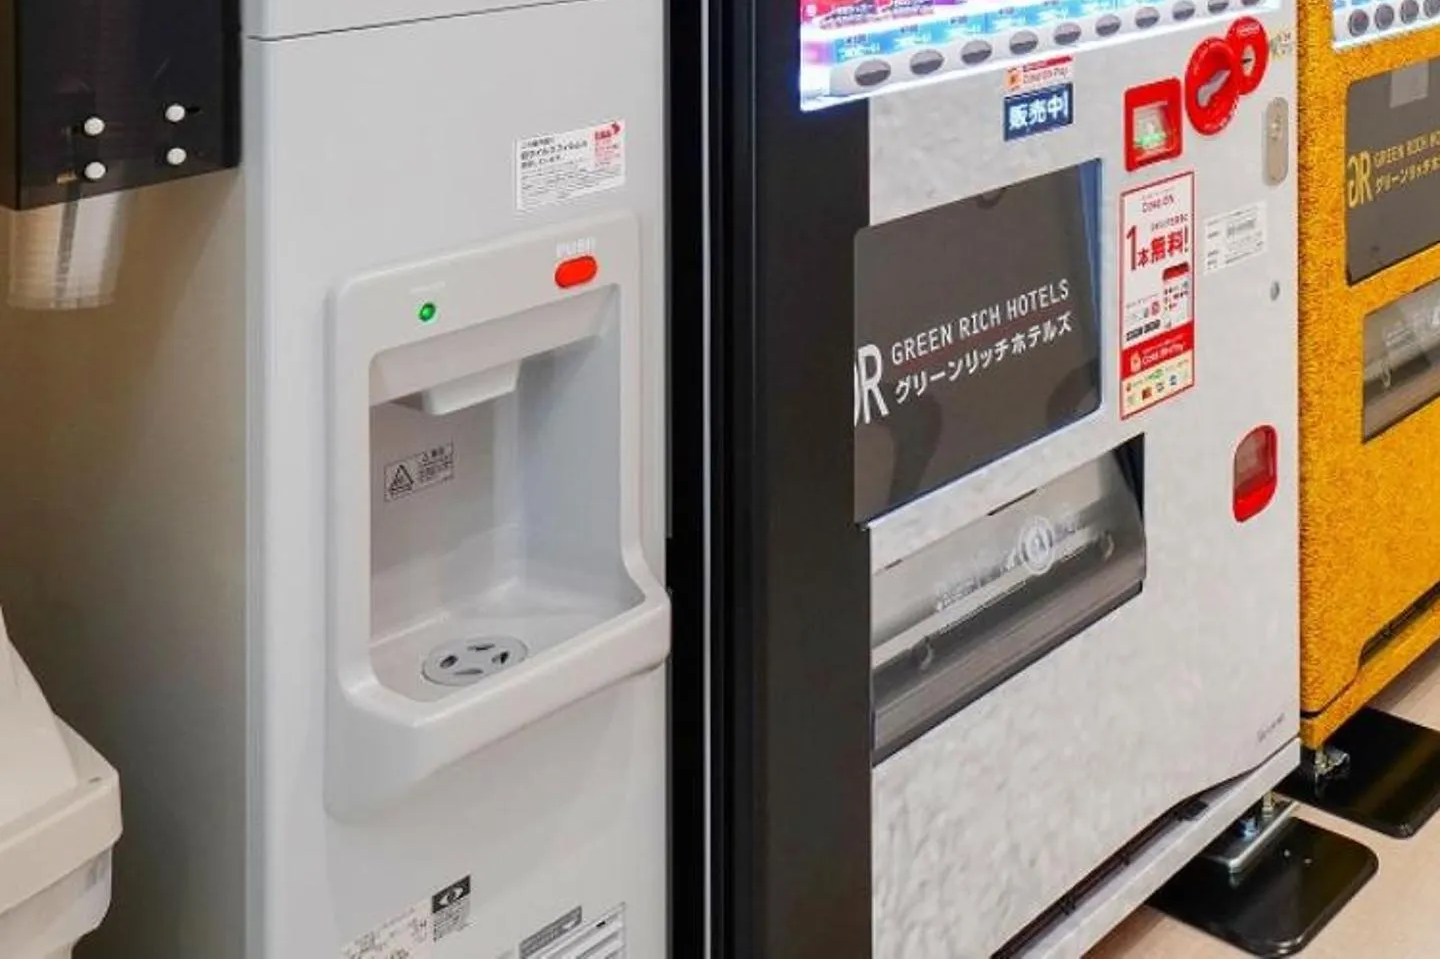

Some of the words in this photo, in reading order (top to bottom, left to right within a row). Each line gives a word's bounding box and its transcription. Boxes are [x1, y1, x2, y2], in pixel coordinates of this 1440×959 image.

[891, 322, 953, 366] GREEN
[958, 304, 1002, 339] RICH
[1006, 278, 1071, 321] HOTELS
[895, 310, 1074, 404] グリーンリッチホテルズ
[854, 343, 890, 427] R
